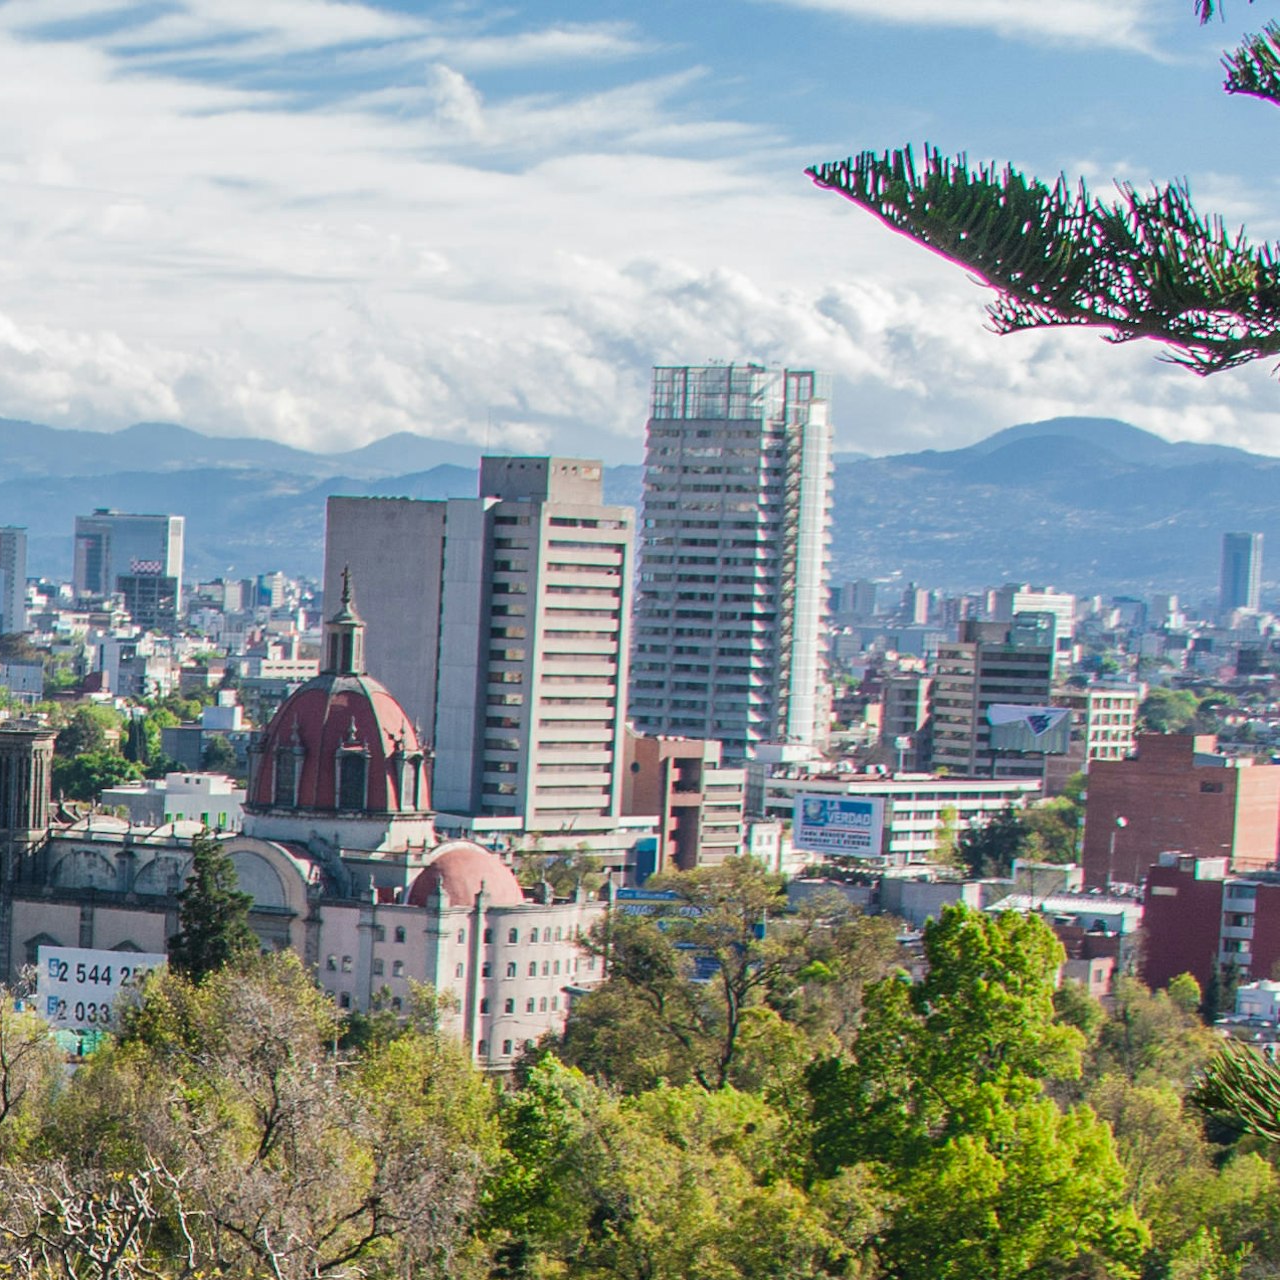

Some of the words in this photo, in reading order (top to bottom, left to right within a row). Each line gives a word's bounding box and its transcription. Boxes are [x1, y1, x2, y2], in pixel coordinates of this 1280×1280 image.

[828, 811, 872, 826] VERDAD
[76, 963, 112, 986] 544
[75, 1001, 110, 1023] 033
